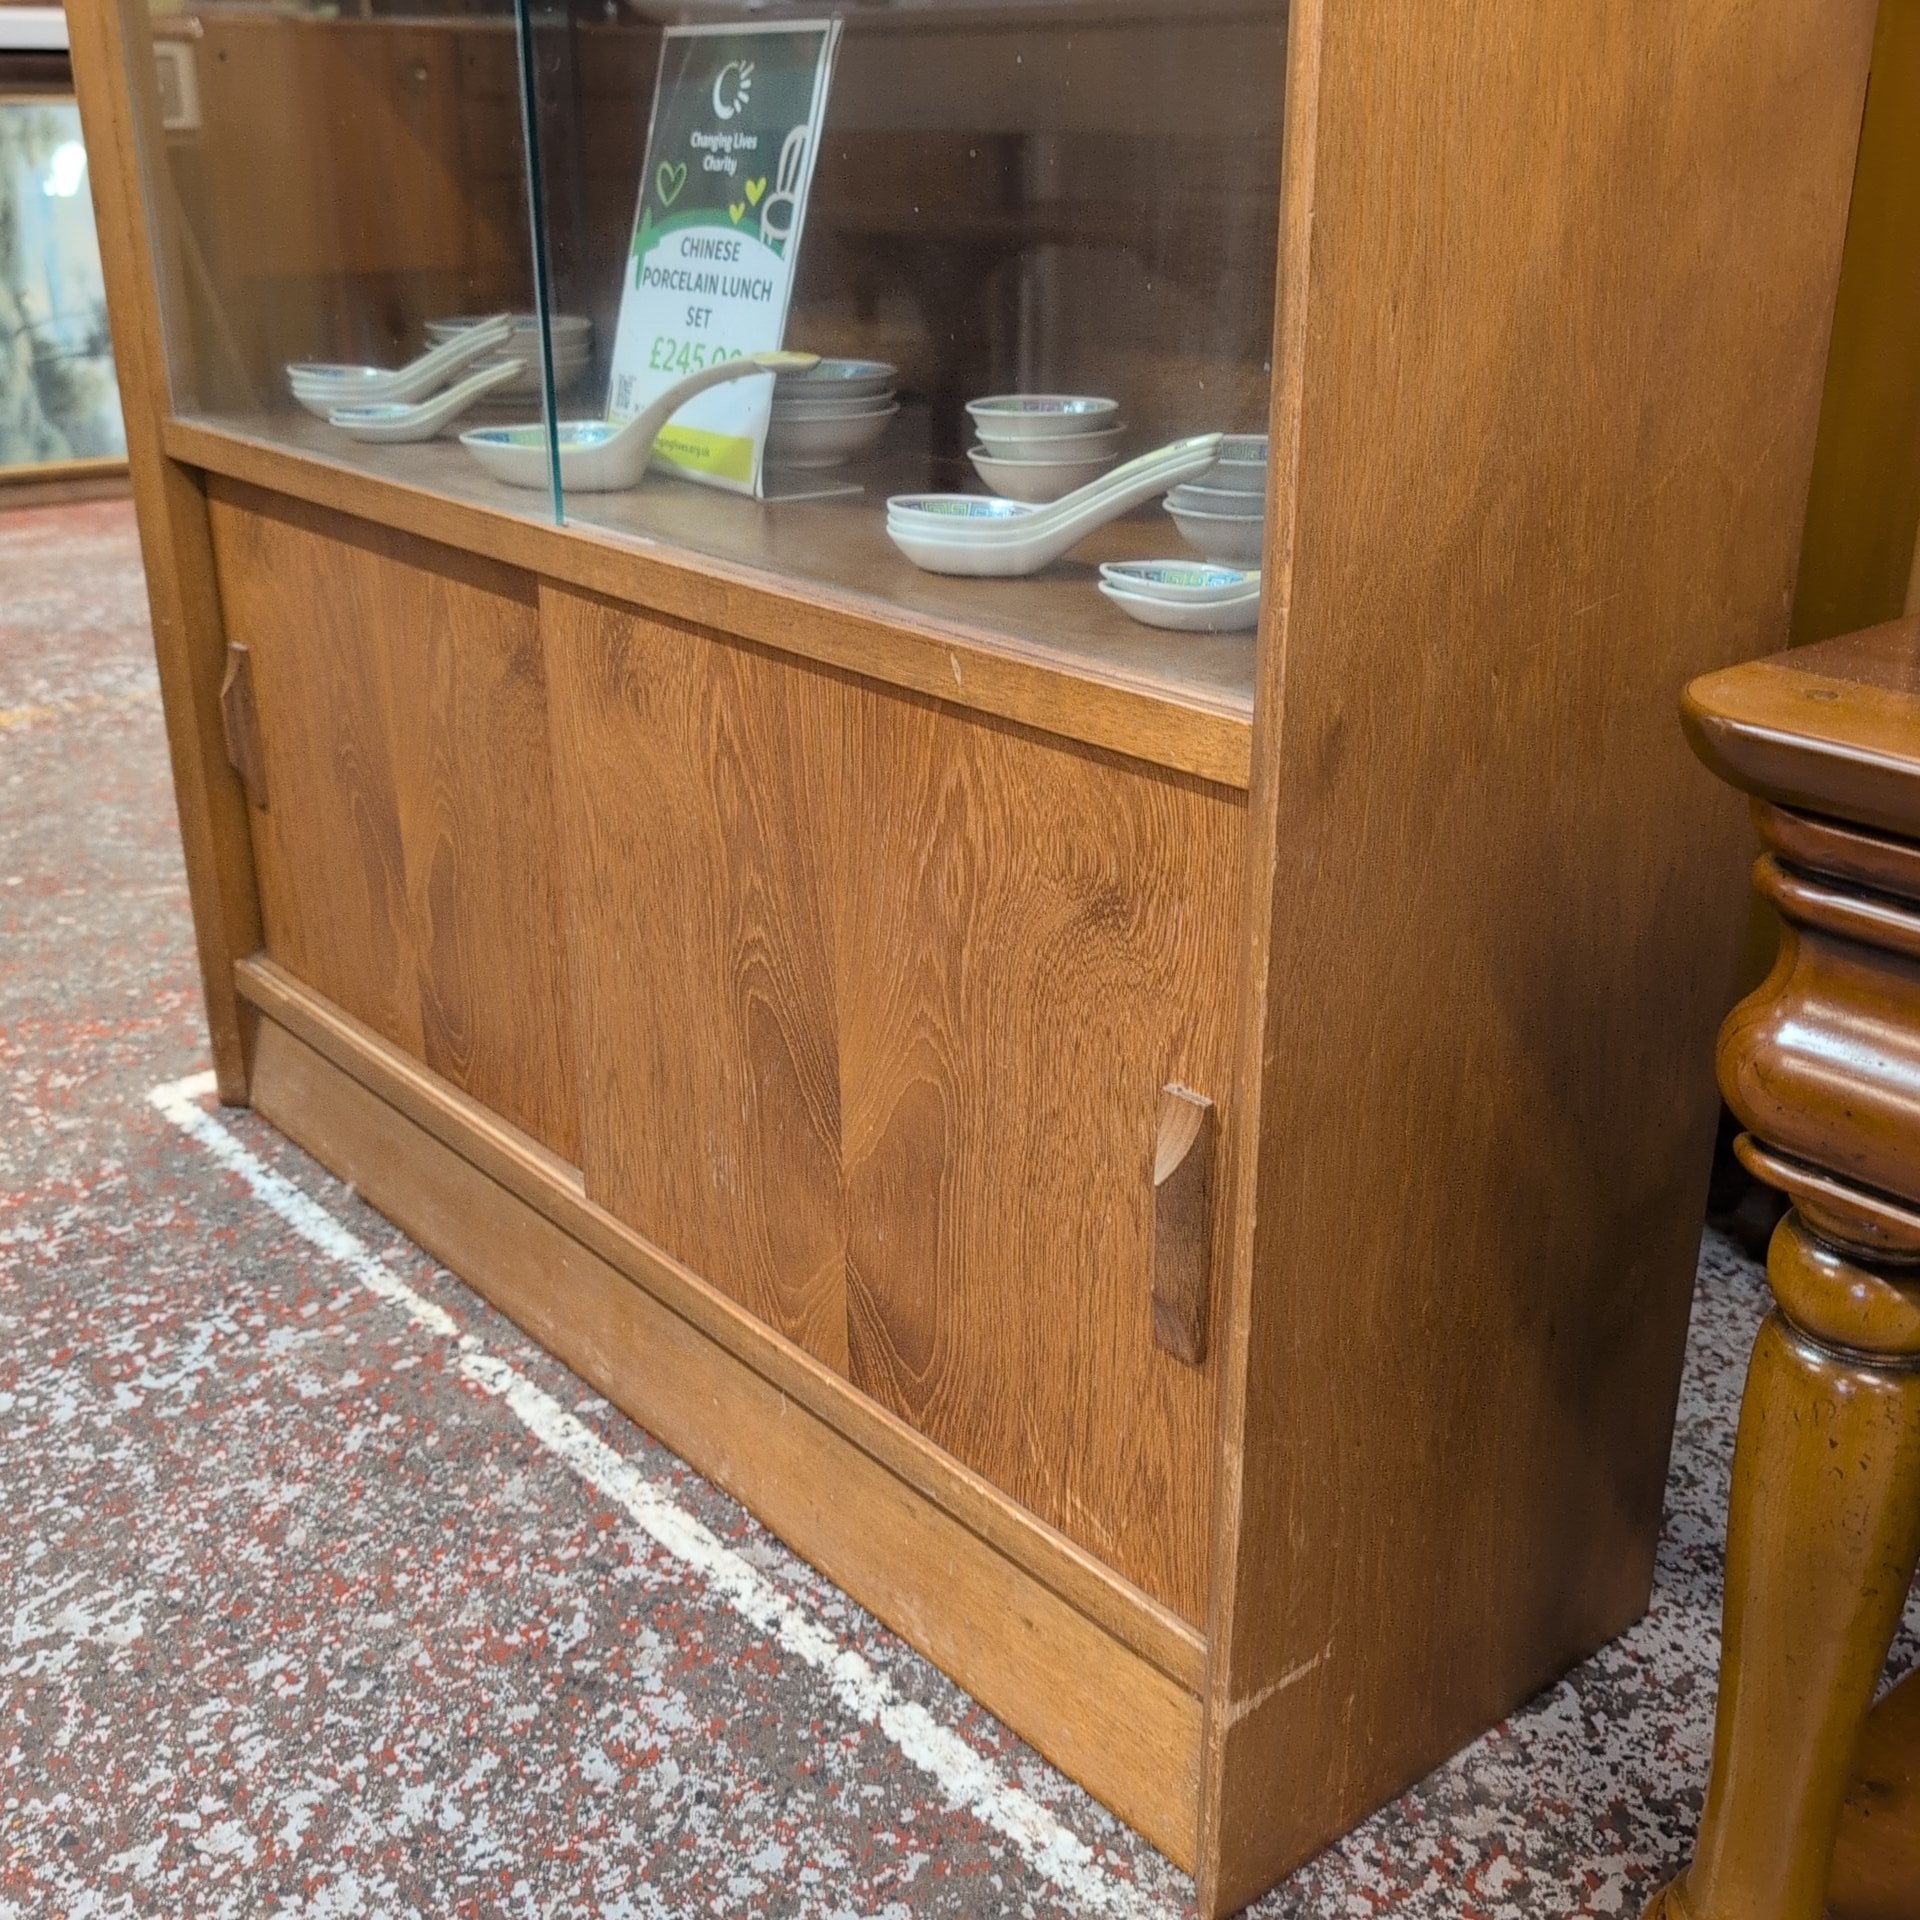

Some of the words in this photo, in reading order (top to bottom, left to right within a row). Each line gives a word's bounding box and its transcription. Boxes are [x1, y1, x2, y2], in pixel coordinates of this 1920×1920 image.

[690, 131, 733, 153] Changing
[733, 132, 758, 150] Lives
[702, 154, 737, 177] Charity
[680, 236, 742, 262] CHINESE
[642, 266, 719, 295] PORCELAIN
[721, 275, 773, 302] LUNCH
[685, 306, 713, 329] SET
